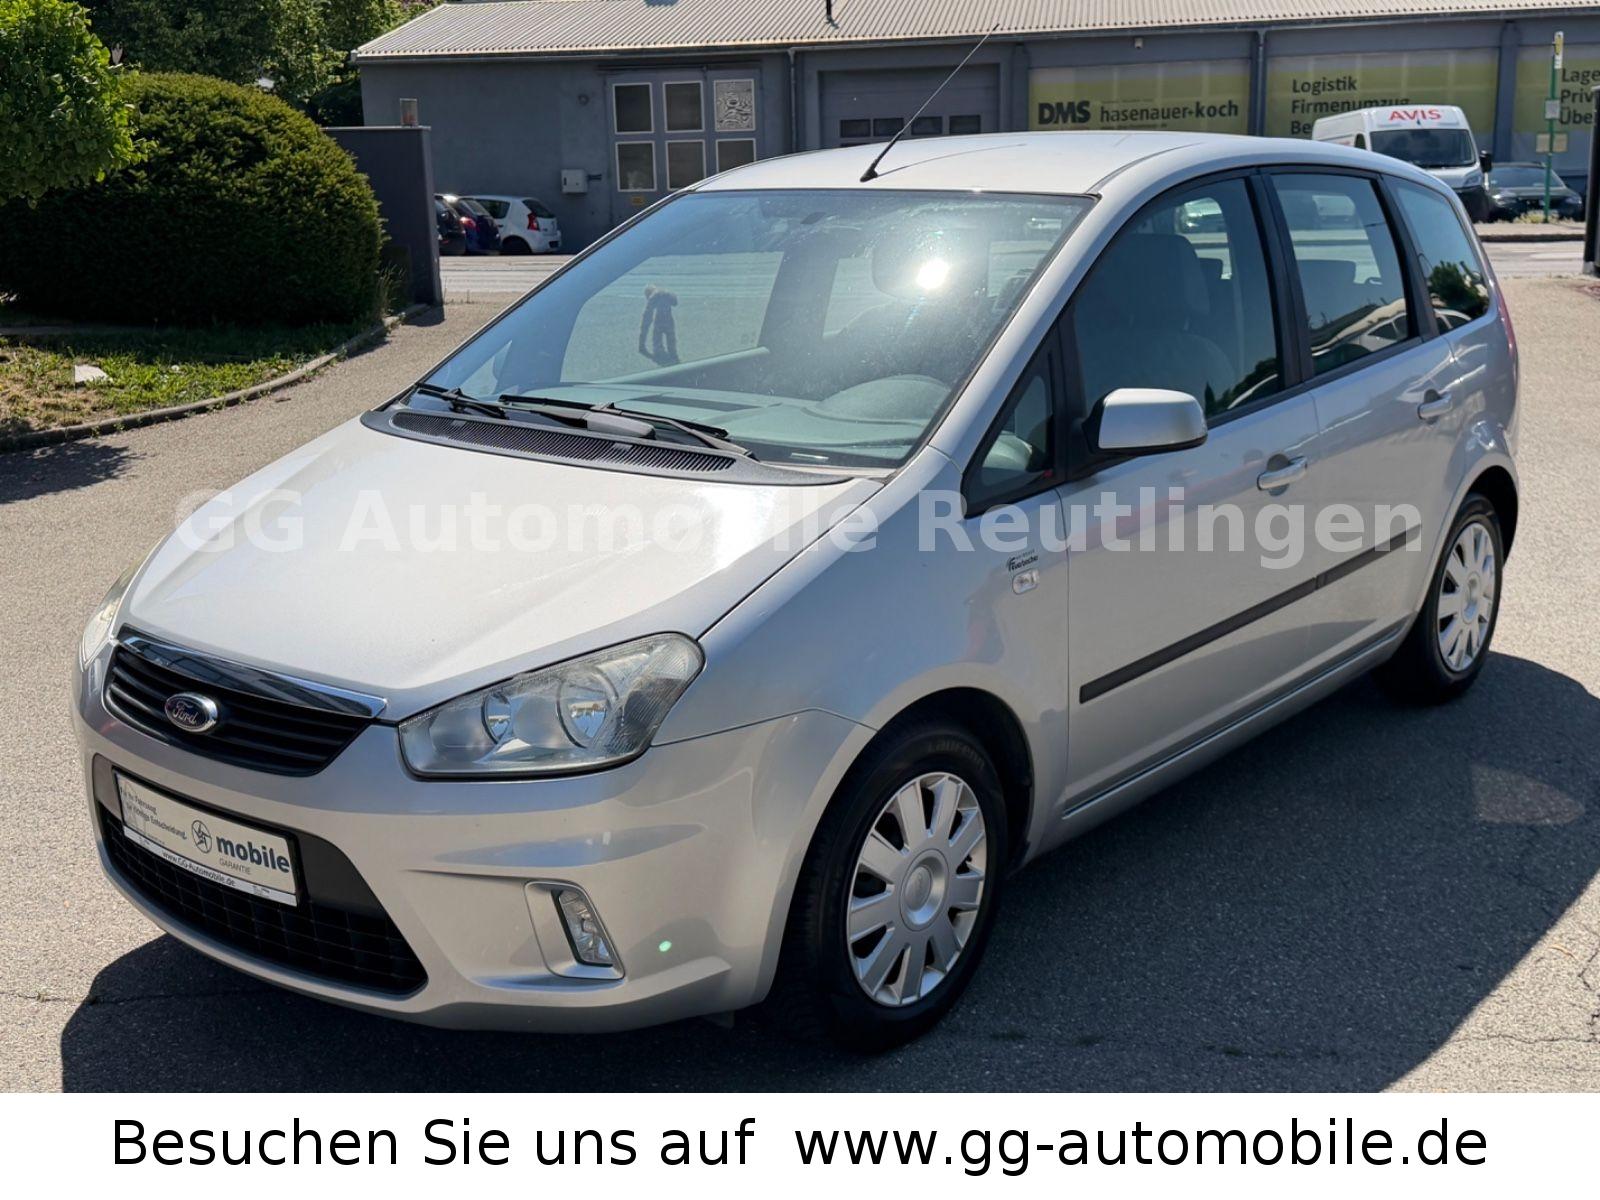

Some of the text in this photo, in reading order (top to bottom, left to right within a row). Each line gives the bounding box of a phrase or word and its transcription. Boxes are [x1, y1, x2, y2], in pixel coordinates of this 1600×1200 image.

[1561, 68, 1600, 85] Lage
[1292, 76, 1358, 96] Logistik
[1560, 88, 1595, 104] Priv
[1038, 100, 1091, 124] DMS
[1388, 108, 1442, 121] AVIS
[1559, 107, 1593, 125] Übe
[1291, 120, 1313, 135] Be
[172, 700, 199, 725] Ford
[216, 835, 291, 873] mobile
[219, 857, 252, 876] GARANTIE
